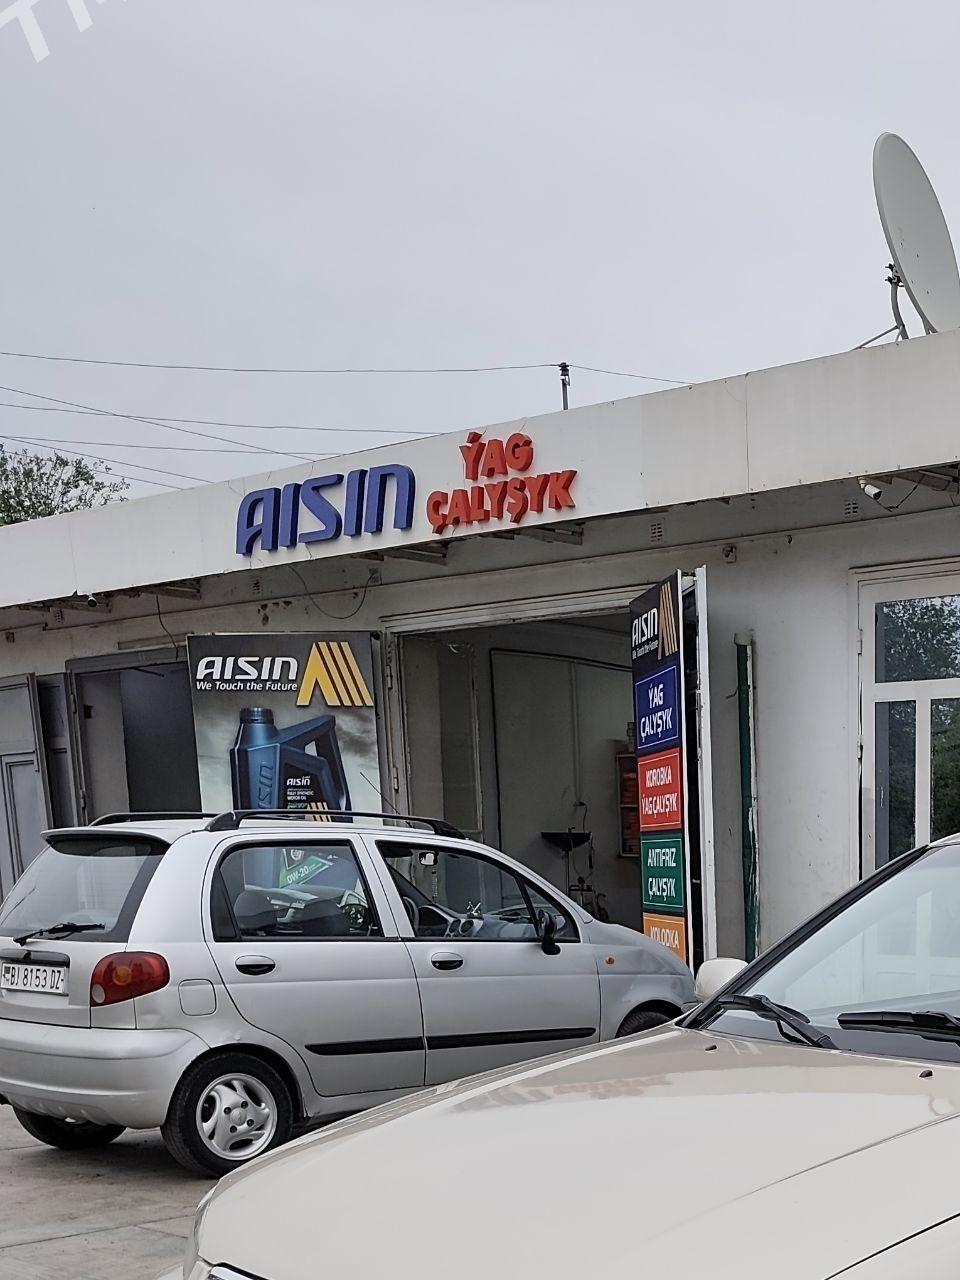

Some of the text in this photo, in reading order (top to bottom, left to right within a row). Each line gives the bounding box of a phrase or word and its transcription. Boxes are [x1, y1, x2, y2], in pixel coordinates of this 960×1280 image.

[459, 431, 534, 481] ÝAG
[236, 464, 416, 556] AISIN
[426, 469, 578, 535] ÇALYŞYK
[632, 608, 658, 647] AISIN
[195, 656, 298, 680] AISIN
[196, 681, 298, 691] We Touch the Future
[648, 683, 664, 709] ÝAG
[640, 707, 673, 743] ÇALYŞYK
[645, 765, 673, 788] KOROBKA
[652, 792, 678, 819] ÇALYŞYK
[647, 848, 677, 867] ANTIFRIZ
[648, 877, 676, 901] ÇALYŞYK
[22, 968, 47, 988] 8153
